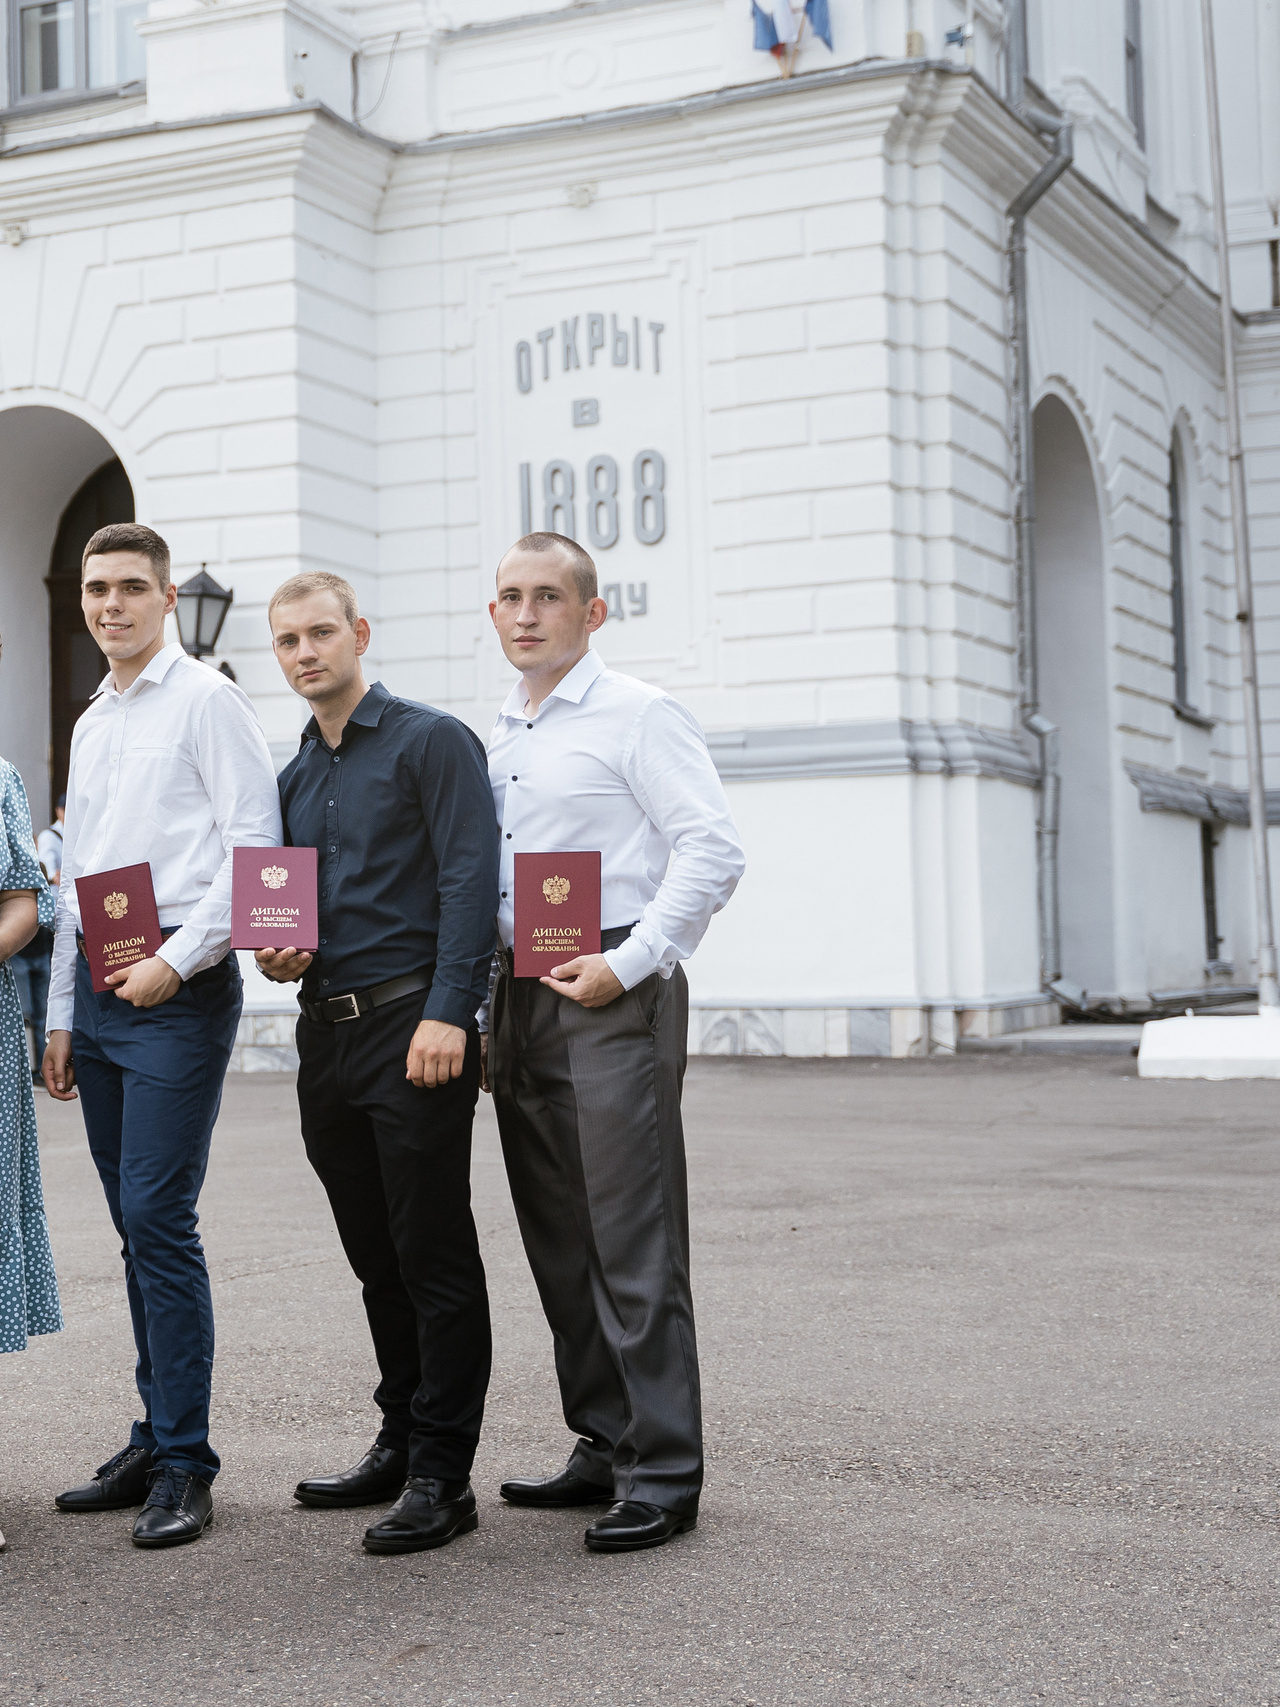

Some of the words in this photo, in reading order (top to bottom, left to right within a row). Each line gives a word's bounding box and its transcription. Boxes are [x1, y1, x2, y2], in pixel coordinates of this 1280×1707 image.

[516, 312, 664, 394] ОТКРЫТ
[573, 398, 600, 428] В
[519, 449, 666, 551] 1888
[603, 581, 649, 622] ДУ
[249, 907, 300, 916] ДИПЛОМ
[532, 927, 582, 938] ДИПЛОМ
[102, 935, 146, 954] ДИПЛОМ
[114, 947, 141, 958] ВЫСШЕМ
[104, 952, 147, 967] ОБРАЗОВАНИИ
